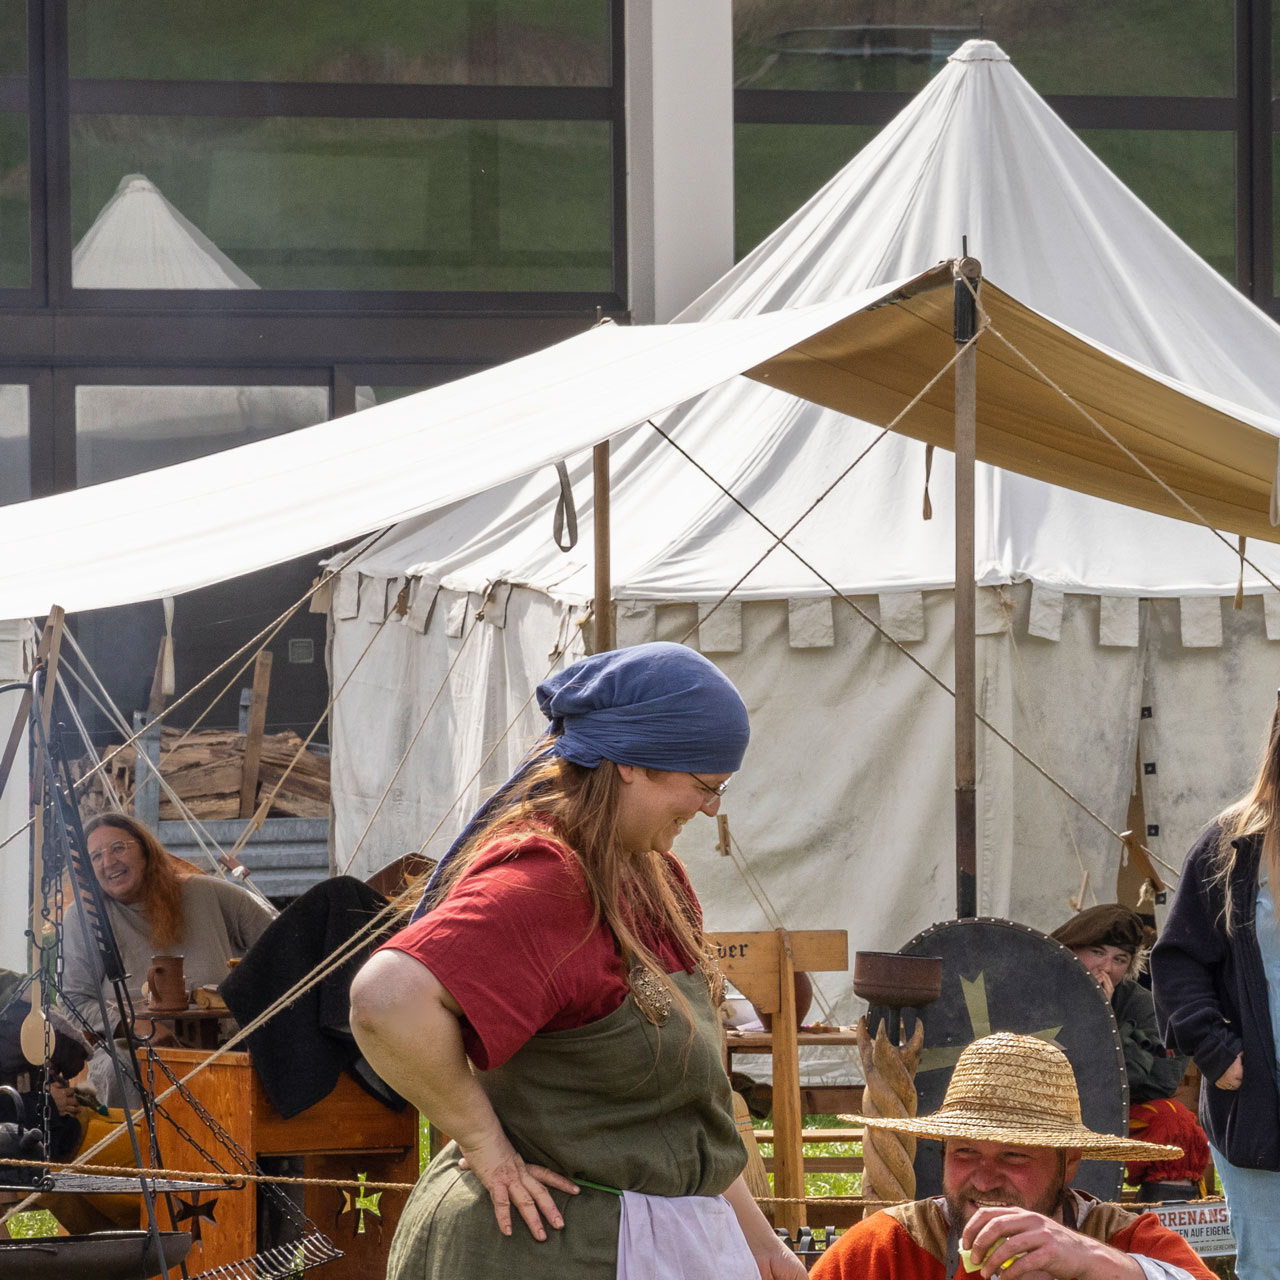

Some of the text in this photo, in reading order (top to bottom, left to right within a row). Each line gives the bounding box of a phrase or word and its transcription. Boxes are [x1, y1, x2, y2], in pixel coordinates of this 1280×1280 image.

[715, 941, 749, 959] der
[1158, 1207, 1228, 1227] RRENANS
[1190, 1227, 1204, 1238] AUF
